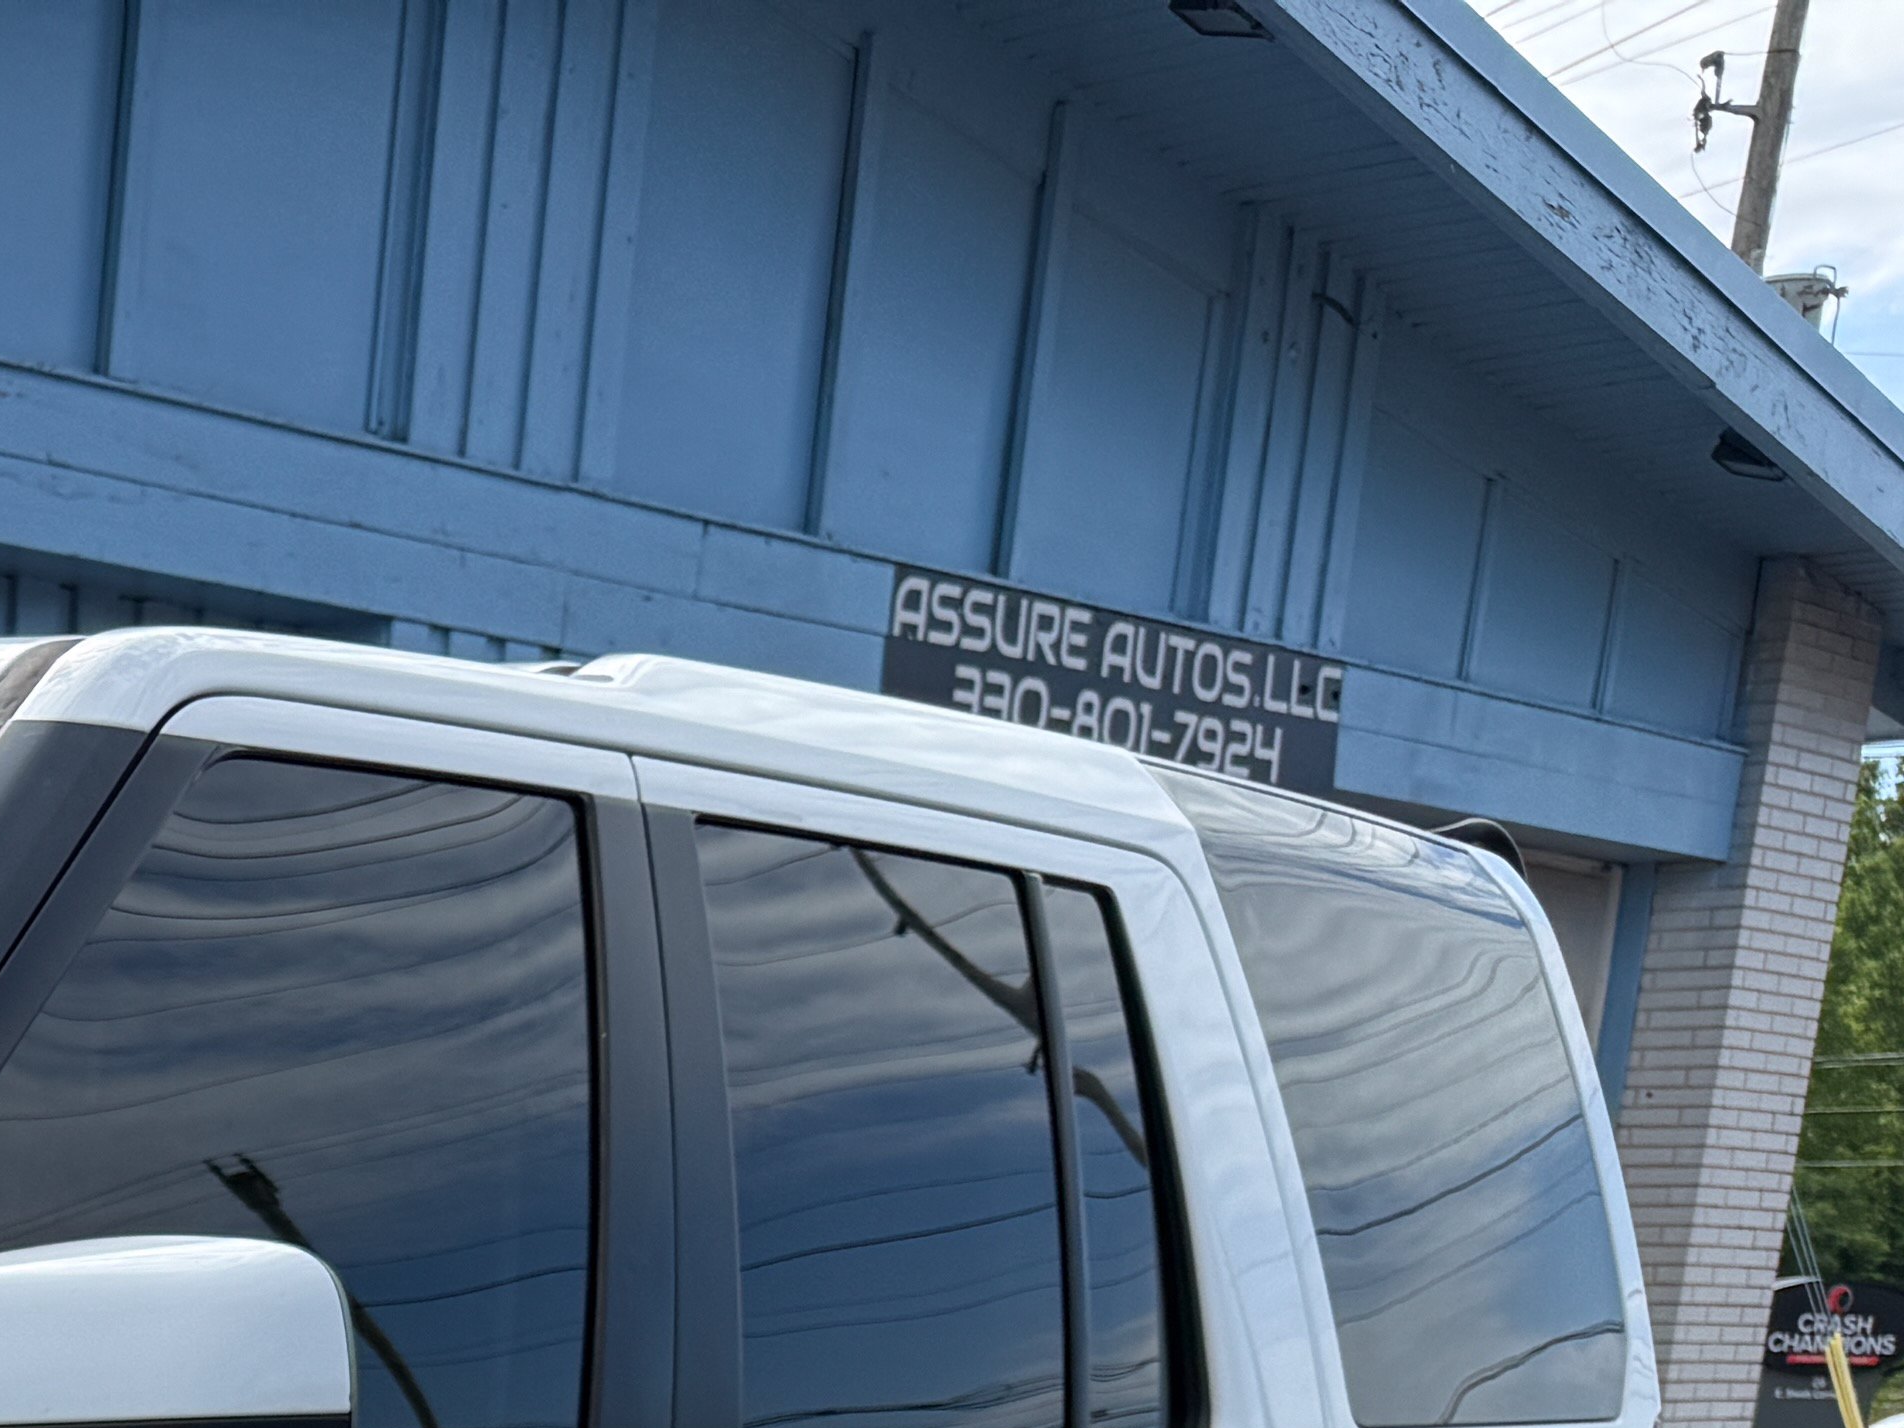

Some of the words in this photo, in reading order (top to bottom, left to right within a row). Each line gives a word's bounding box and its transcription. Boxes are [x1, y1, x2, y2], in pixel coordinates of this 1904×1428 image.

[894, 575, 1092, 671] ASSURE
[953, 664, 1283, 785] 330-801-7924
[1767, 1330, 1897, 1356] CHAMIONS
[1797, 1312, 1874, 1336] CRASH
